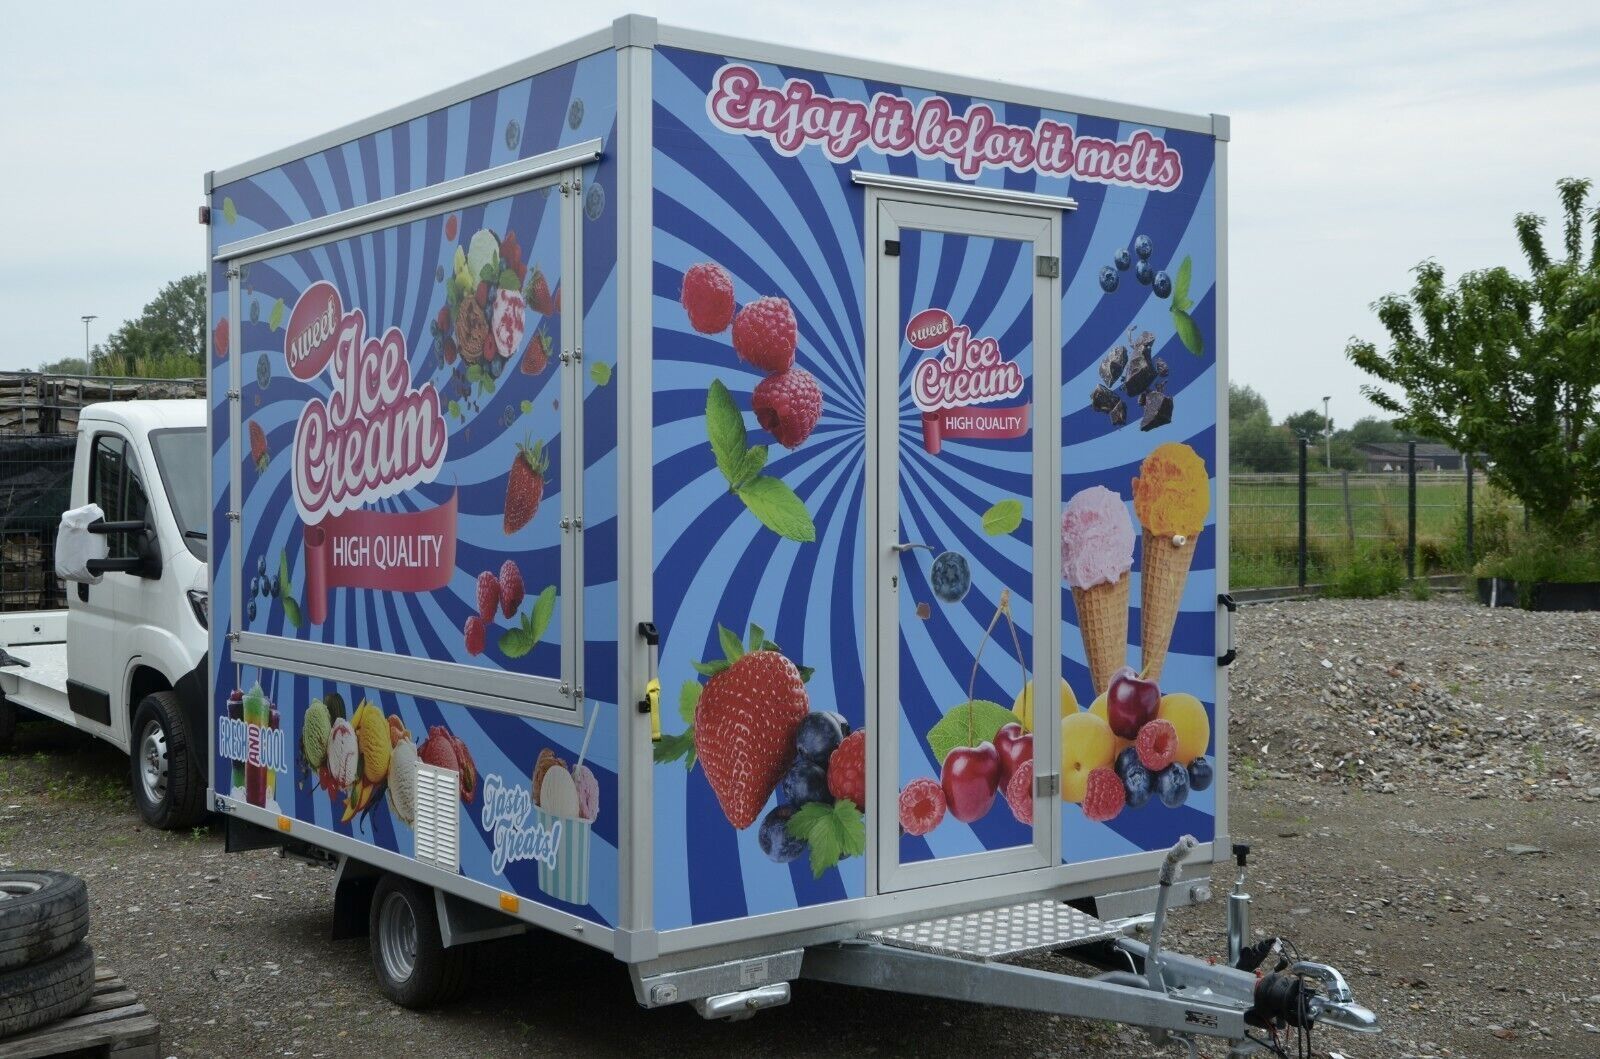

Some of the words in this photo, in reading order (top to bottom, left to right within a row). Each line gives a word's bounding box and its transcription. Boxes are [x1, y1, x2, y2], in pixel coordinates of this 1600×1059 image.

[711, 68, 867, 160] Enjoy
[871, 97, 911, 152] it
[915, 100, 1034, 177] befor
[1035, 121, 1071, 173] it
[1075, 133, 1180, 188] melts
[290, 296, 338, 369] sweet
[910, 317, 949, 343] sweet
[943, 328, 998, 372] Ice
[329, 314, 407, 429] Ice
[913, 361, 1021, 409] Cream
[295, 386, 444, 515] Cream
[945, 416, 973, 430] HIGH
[976, 416, 1022, 431] QUALITY
[333, 536, 370, 567] HIGH
[374, 535, 443, 570] QUALITY
[219, 716, 248, 762] FRESH
[248, 724, 260, 767] AND
[260, 725, 287, 773] COOL
[482, 774, 531, 831] Tasty
[492, 819, 562, 875] Treats!
